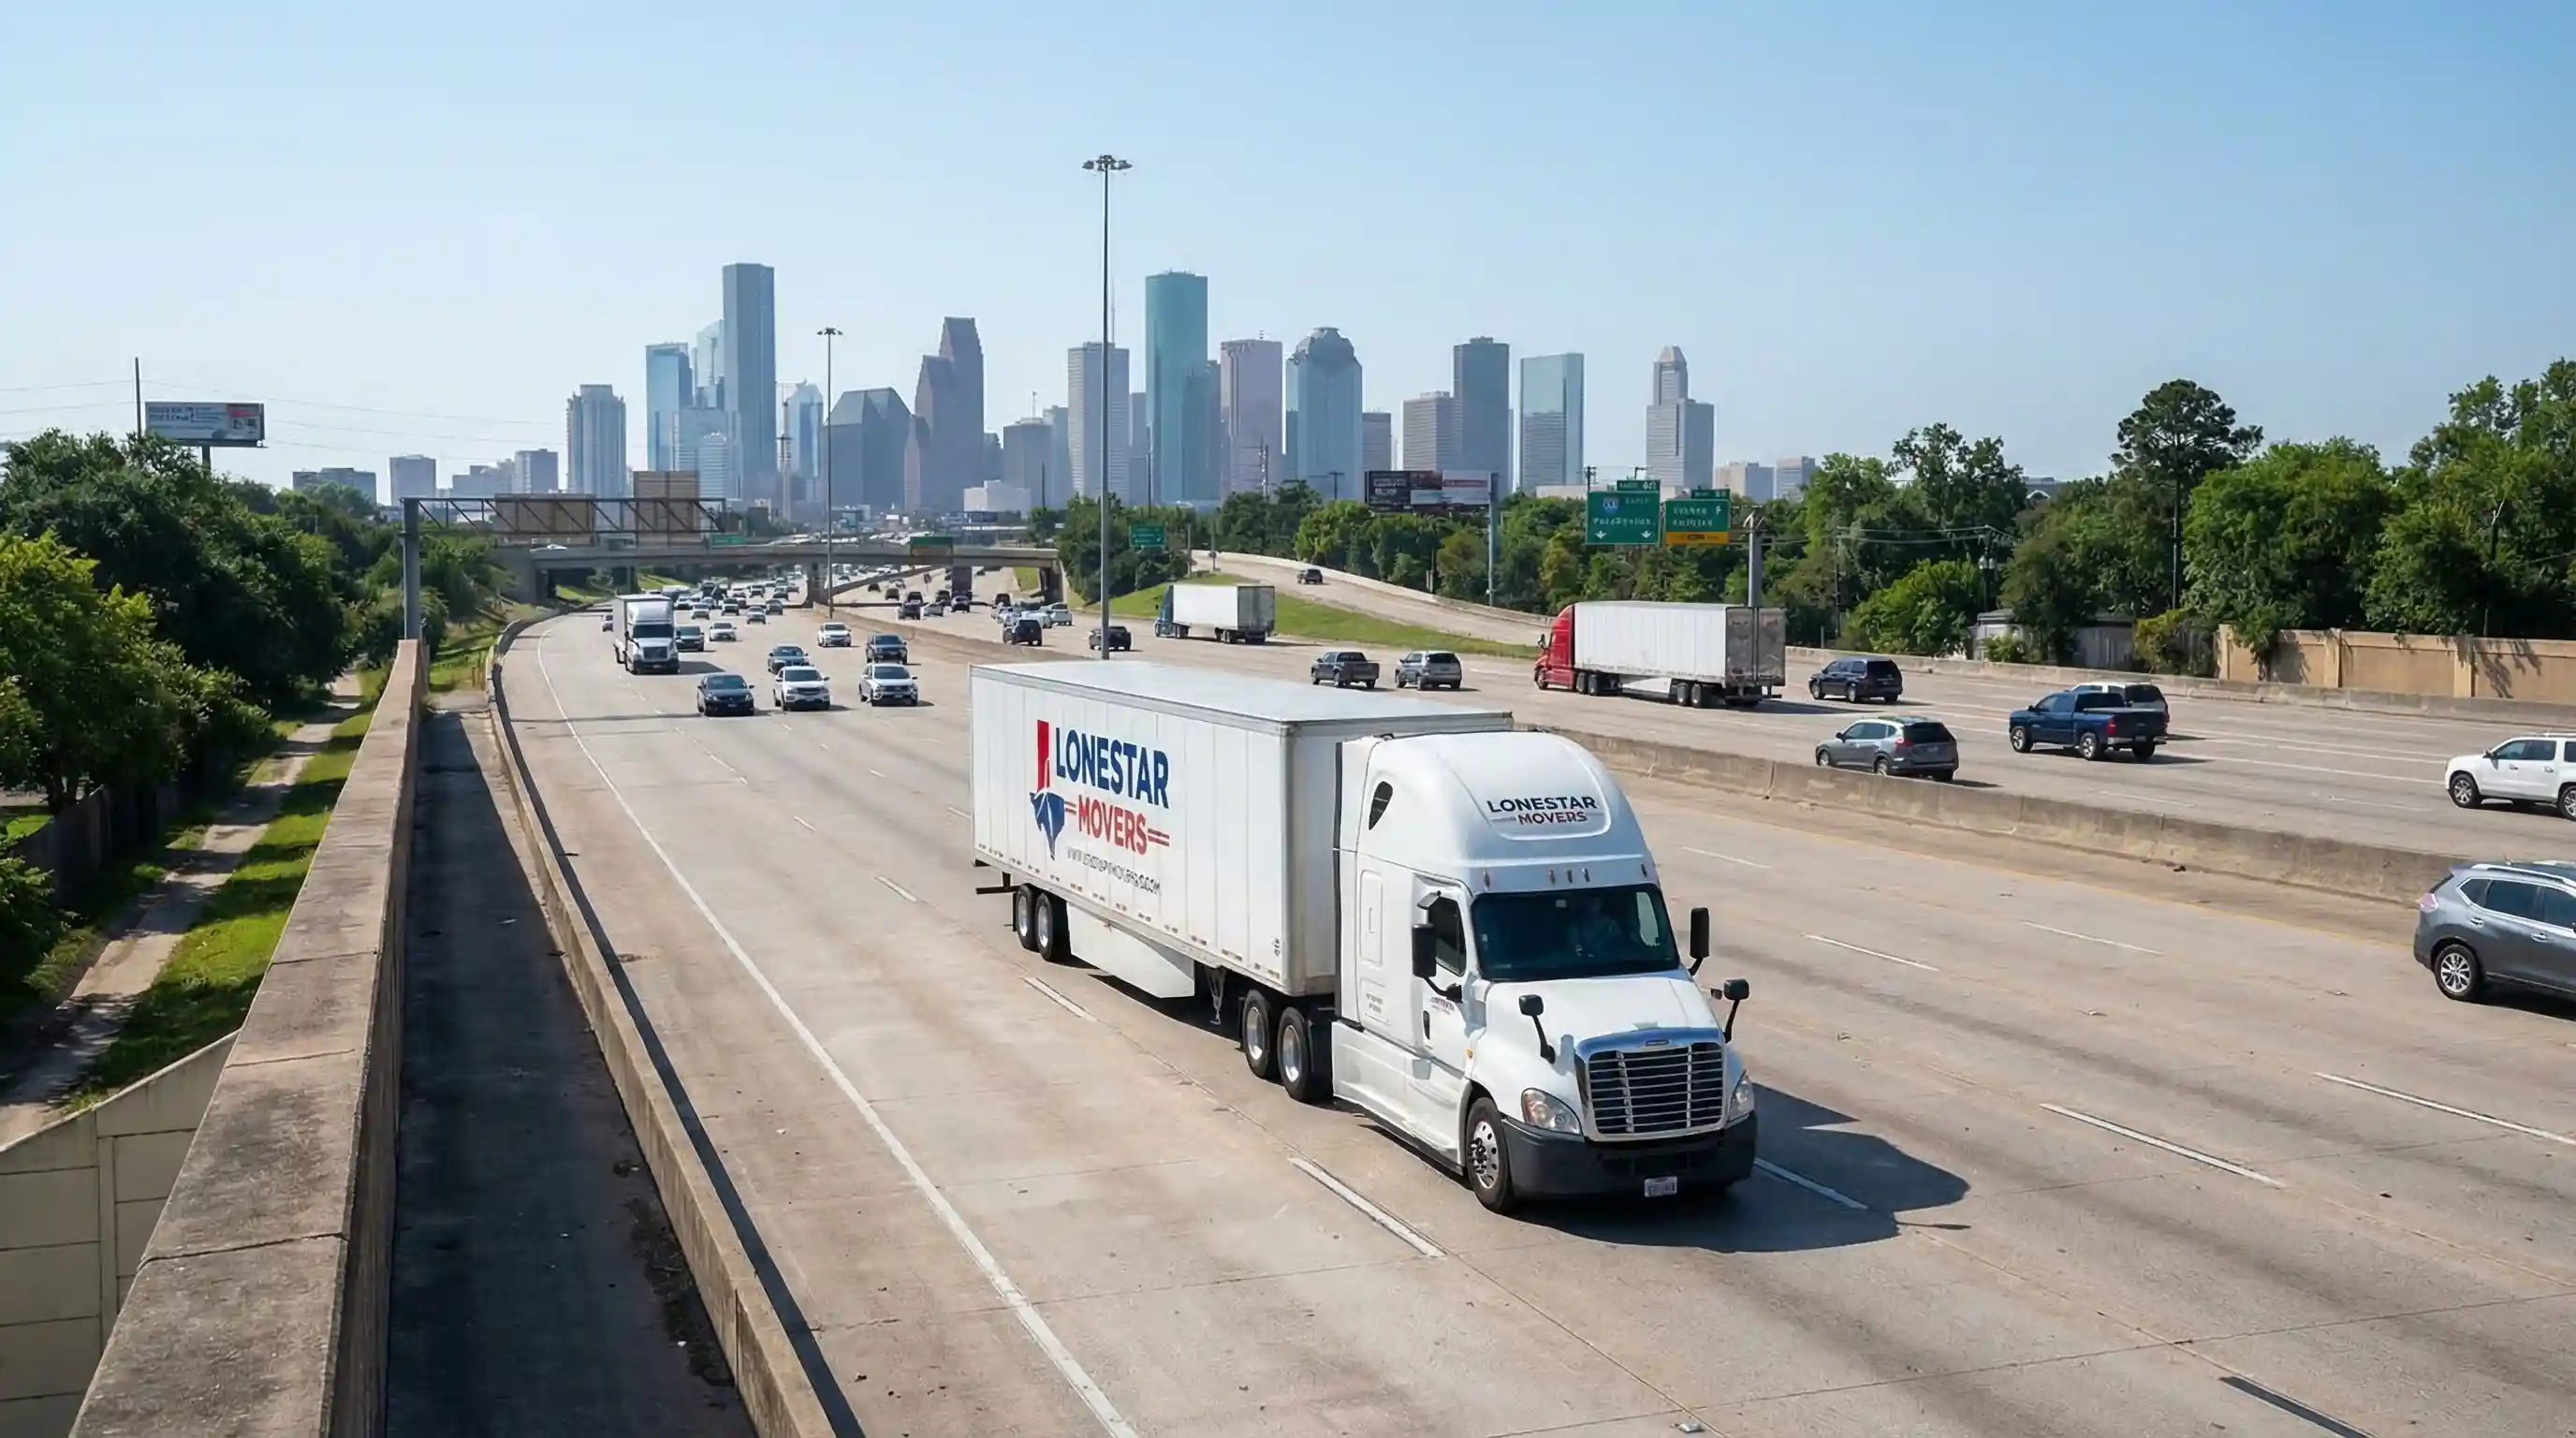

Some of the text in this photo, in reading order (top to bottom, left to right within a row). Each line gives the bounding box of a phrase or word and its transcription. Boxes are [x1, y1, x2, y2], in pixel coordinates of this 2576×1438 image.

[1055, 727, 1170, 809] LONESTAR
[1486, 796, 1598, 813] LONESTAR
[1517, 811, 1588, 826] MOVERS
[1078, 795, 1148, 856] MOVERS
